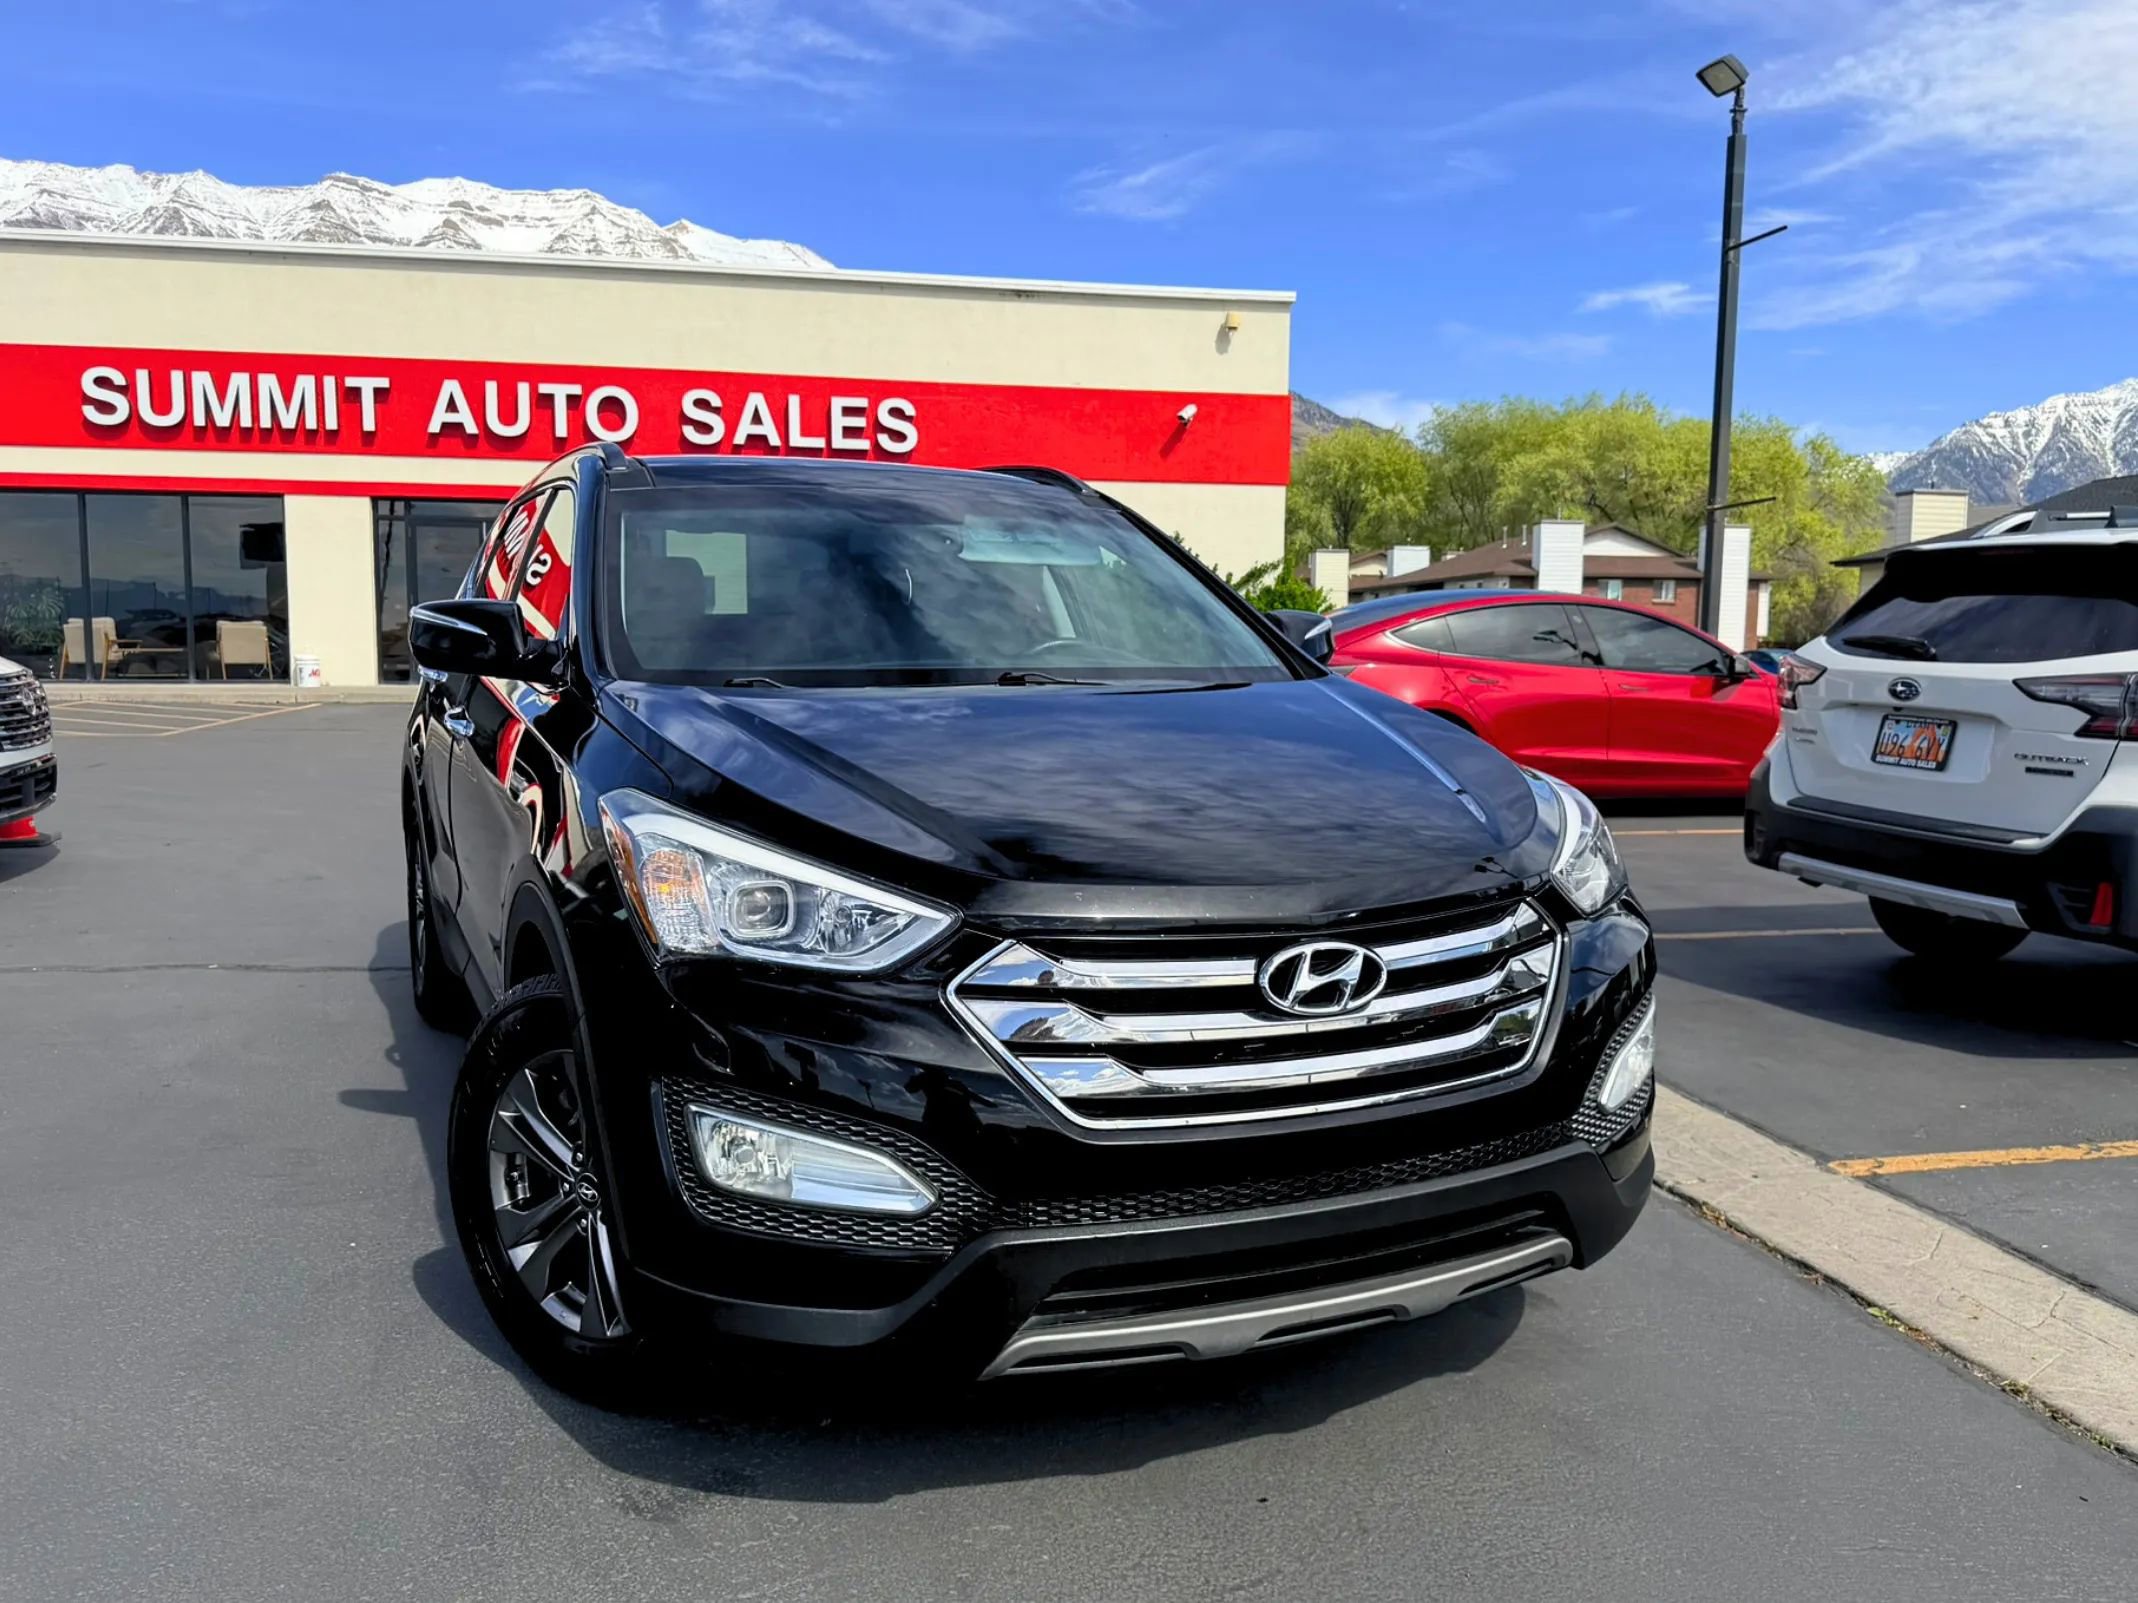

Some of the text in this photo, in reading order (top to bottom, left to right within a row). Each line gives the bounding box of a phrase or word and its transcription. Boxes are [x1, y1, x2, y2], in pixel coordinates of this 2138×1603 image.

[81, 366, 918, 453] SUMMIT AUTO SALES
